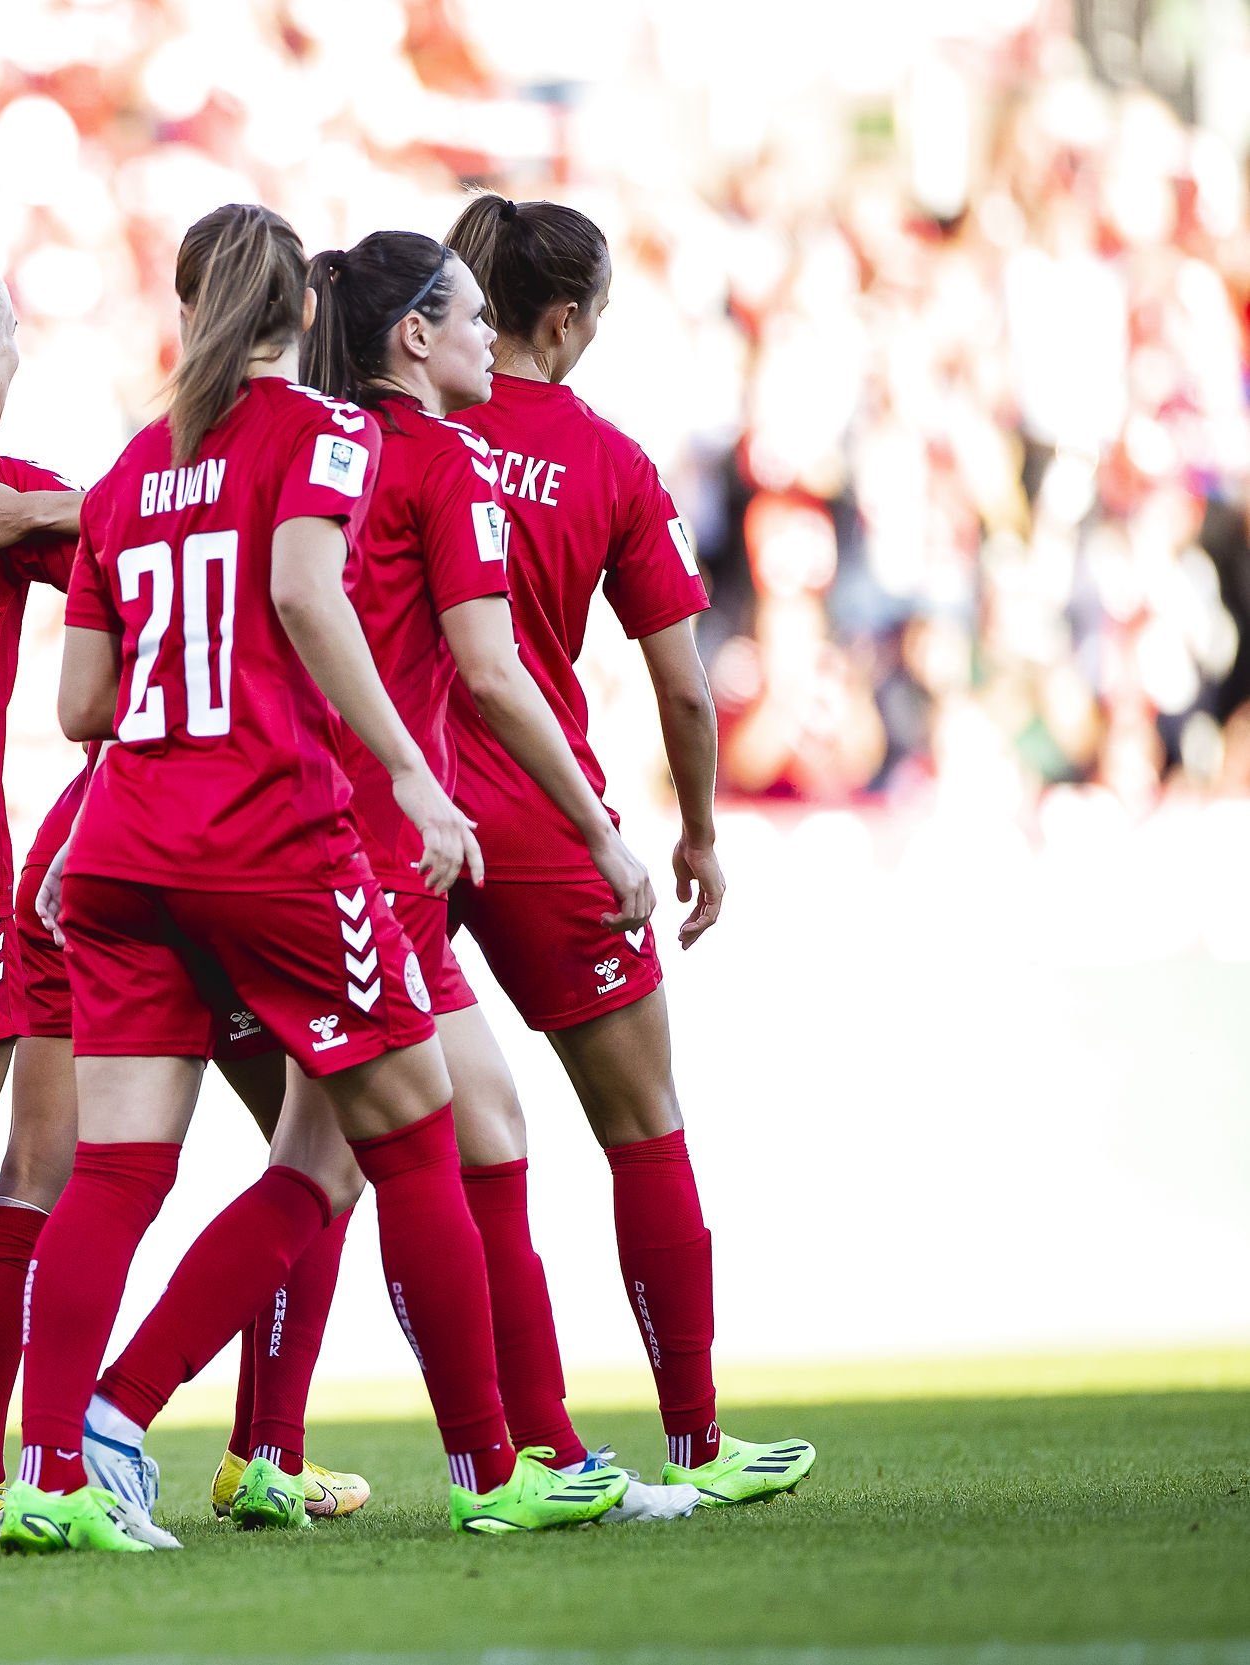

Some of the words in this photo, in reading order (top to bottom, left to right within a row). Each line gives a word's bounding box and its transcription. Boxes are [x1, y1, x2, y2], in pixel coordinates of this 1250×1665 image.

[140, 458, 227, 518] BRUUN
[490, 449, 567, 507] CKE
[117, 529, 238, 743] 20
[597, 973, 627, 995] hummel
[229, 1025, 261, 1041] hummel
[269, 1285, 287, 1357] ANMARK
[635, 1280, 662, 1369] DANMARK
